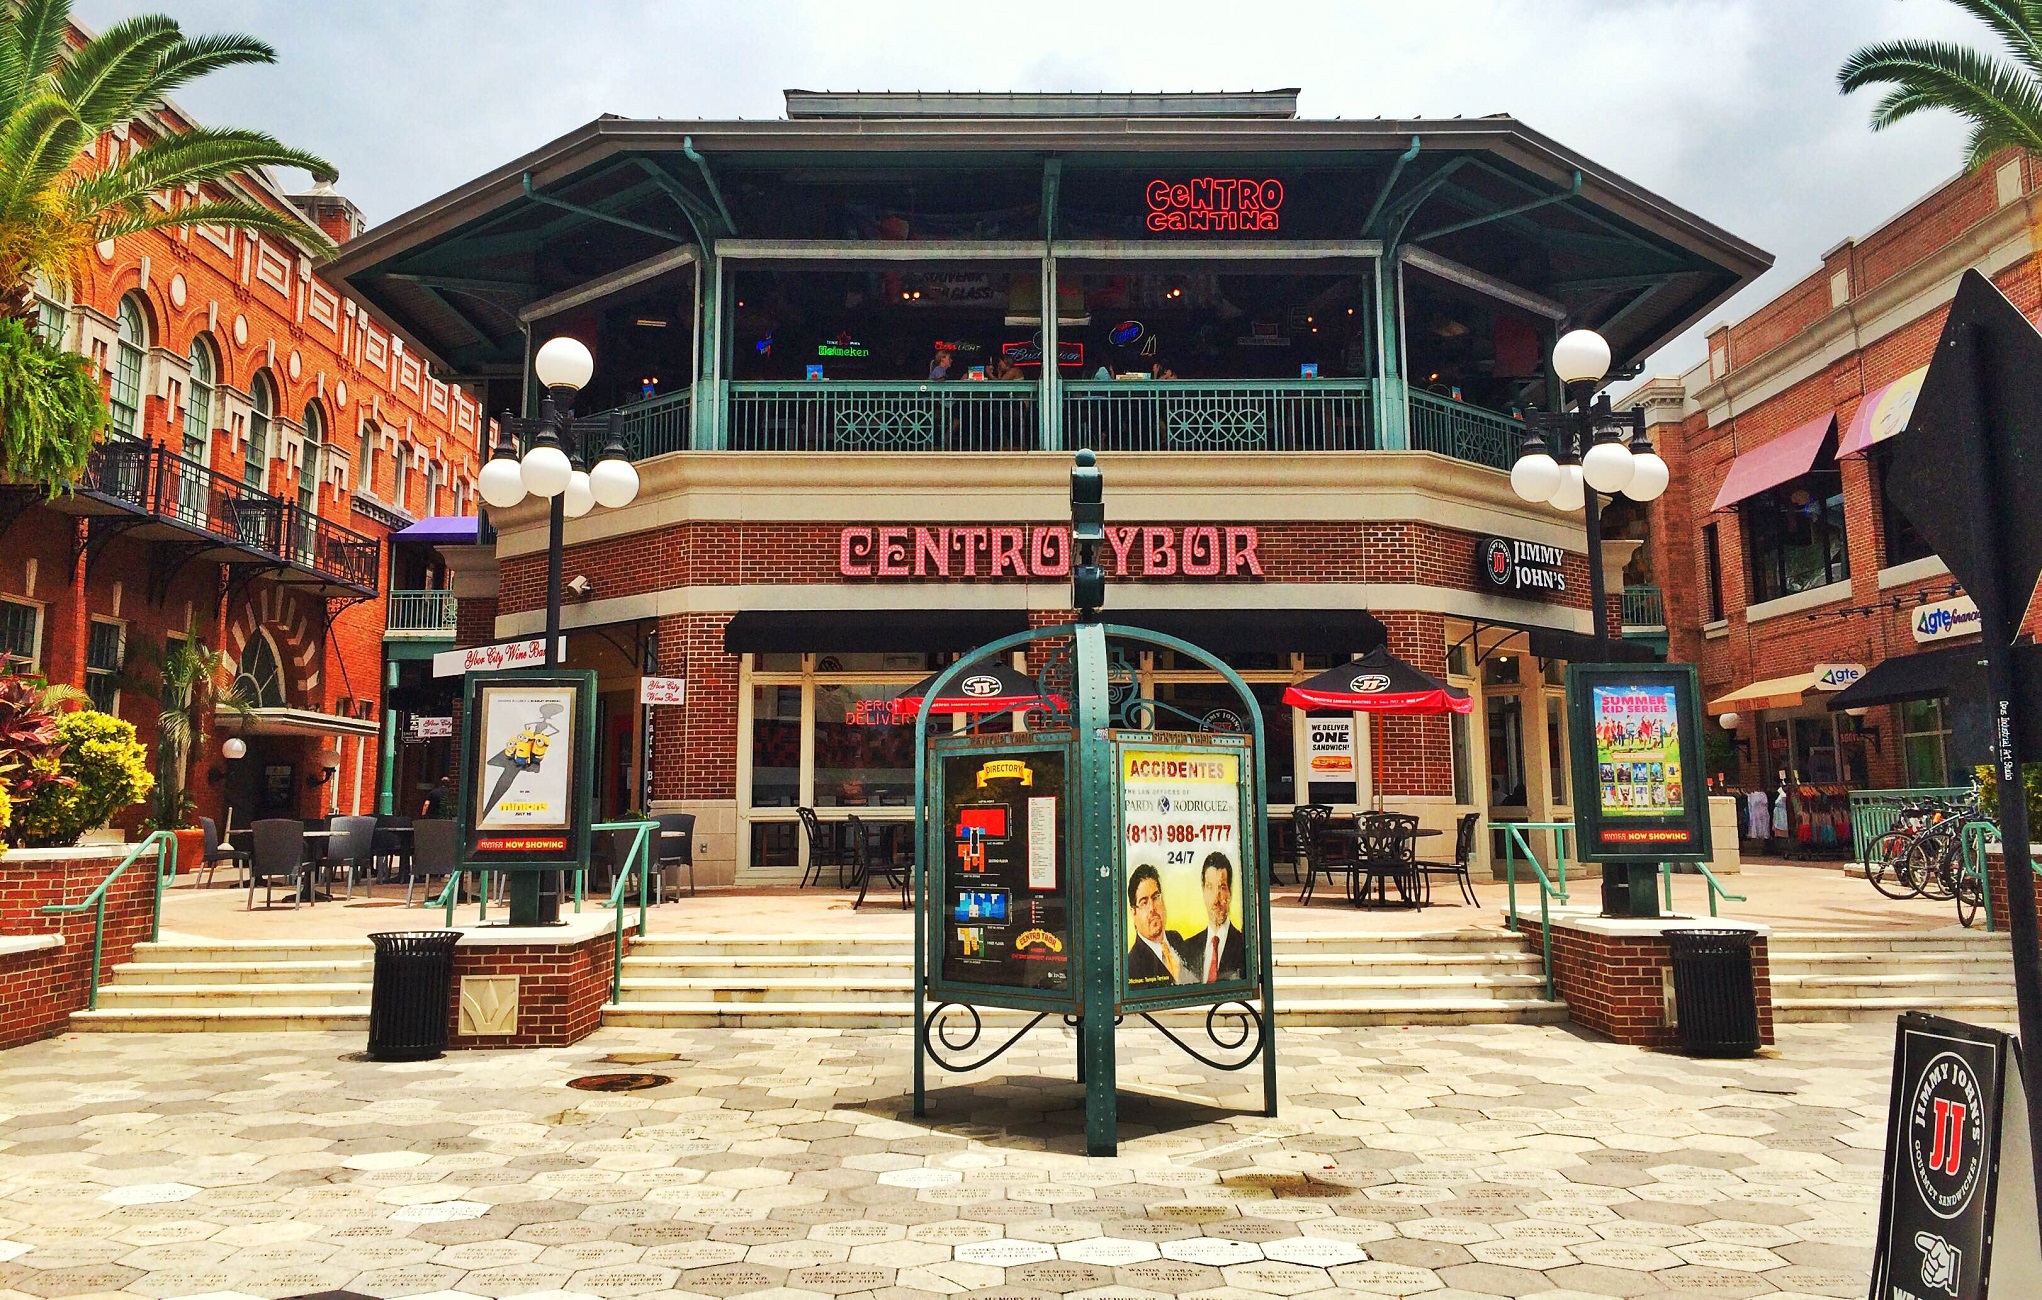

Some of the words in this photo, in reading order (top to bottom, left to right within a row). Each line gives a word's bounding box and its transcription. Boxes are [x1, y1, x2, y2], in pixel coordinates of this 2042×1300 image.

[818, 346, 869, 357] Heineken
[1006, 348, 1080, 361] Budiser
[840, 526, 1070, 577] CENTRO
[1103, 526, 1264, 577] YBOR
[1513, 541, 1564, 566] JIMMY
[1515, 566, 1566, 590] JOHN'S
[486, 647, 503, 668] City
[505, 643, 527, 661] Wine
[529, 641, 546, 658] Ba
[1836, 669, 1859, 683] gte
[1602, 696, 1666, 705] SUMMER
[1602, 706, 1624, 714] KID
[1627, 705, 1668, 713] SERIES
[1312, 732, 1349, 743] ONE
[2001, 717, 2011, 747] Industrial
[2003, 749, 2011, 760] Art
[986, 763, 1023, 774] DIRECTORY
[1130, 760, 1225, 779] ACCIDENTES
[2004, 761, 2014, 781] Studio
[1174, 800, 1228, 812] RODRIGUEZ
[1126, 823, 1163, 846] (813)
[1167, 824, 1231, 843] 988-1777
[525, 841, 563, 849] SHOWING
[1167, 851, 1195, 864] 24/7
[1915, 1062, 1949, 1128] JIMMY
[1951, 1063, 1980, 1142] JOHN'S
[1929, 1097, 1967, 1177] JJ
[1915, 1139, 1938, 1201] GOURMET
[1938, 1156, 1978, 1207] SANDWICHES
